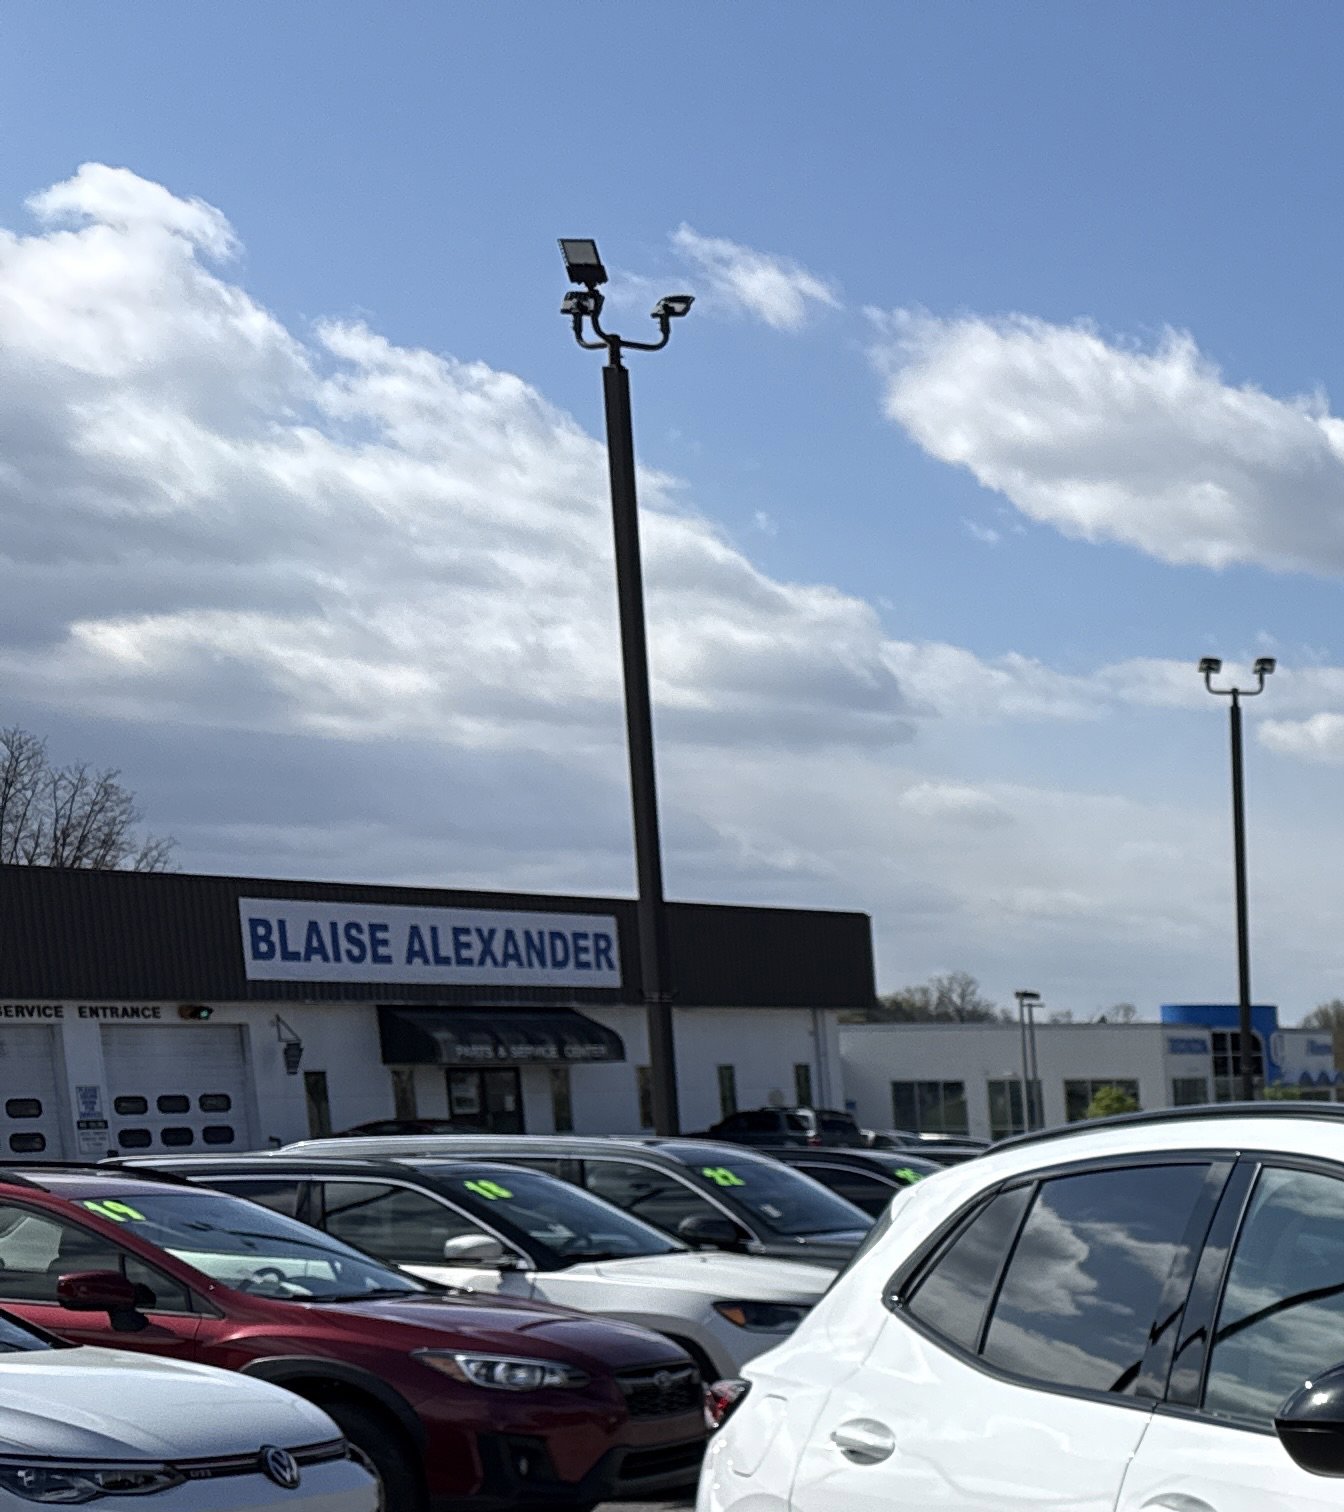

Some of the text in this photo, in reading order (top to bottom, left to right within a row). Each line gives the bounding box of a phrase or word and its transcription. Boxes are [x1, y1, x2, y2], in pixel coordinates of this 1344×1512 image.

[248, 917, 616, 971] BLAISE ALEXANDER
[78, 1006, 161, 1018] ENTRANCE
[511, 1044, 559, 1058] SERVICE
[83, 1200, 146, 1222] 19
